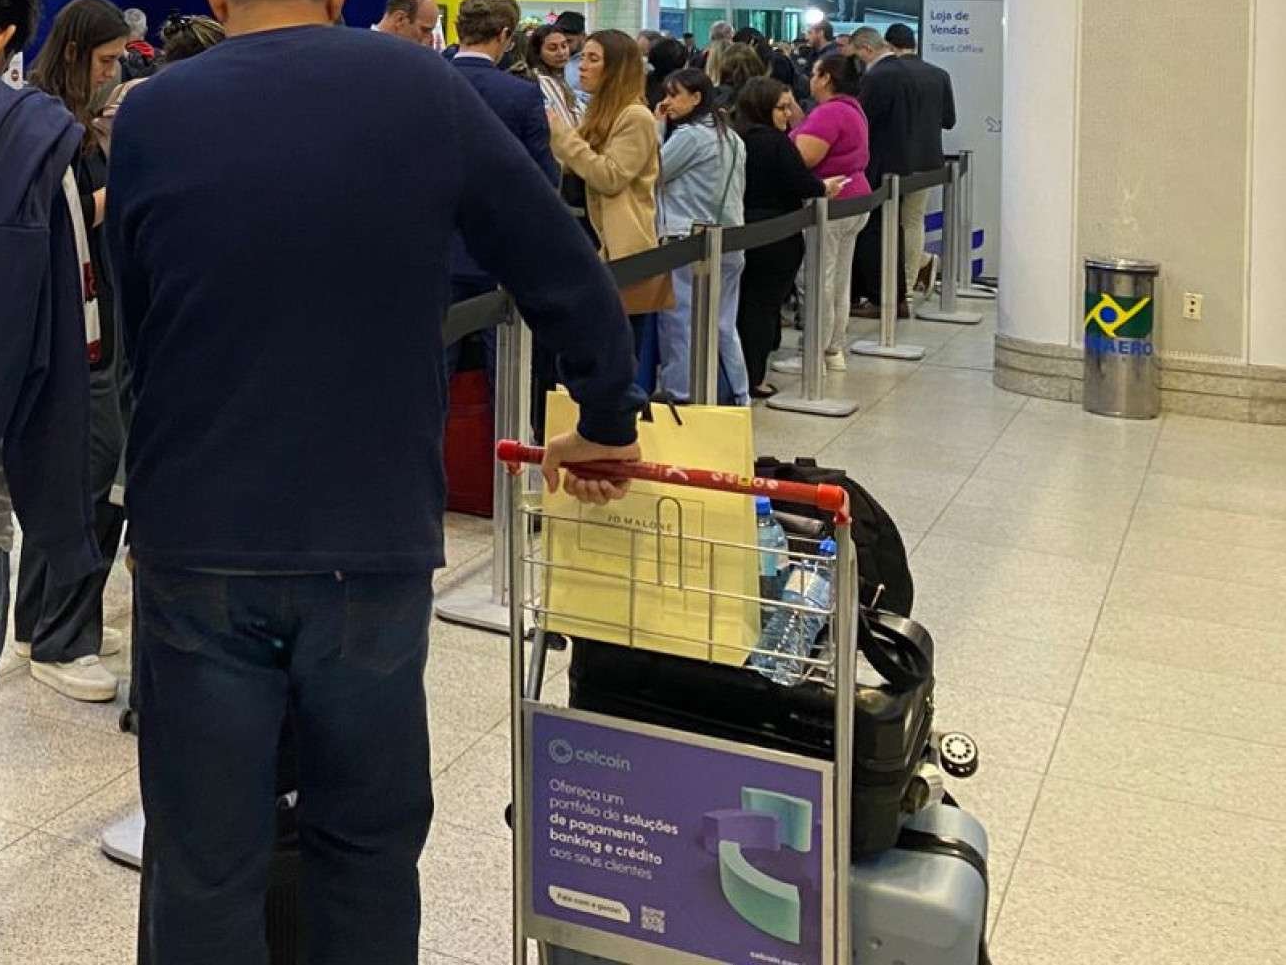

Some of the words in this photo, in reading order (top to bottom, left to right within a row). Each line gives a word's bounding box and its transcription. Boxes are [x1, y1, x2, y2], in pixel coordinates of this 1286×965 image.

[930, 10, 952, 23] Loja
[954, 9, 970, 21] de
[930, 23, 970, 35] Vendas
[575, 748, 632, 772] celcoin
[549, 778, 601, 801] Ofereça
[602, 794, 625, 806] um
[549, 812, 567, 826] de
[602, 808, 620, 821] de
[622, 813, 679, 835] soluções
[549, 827, 602, 854] banking
[604, 843, 613, 854] e
[615, 846, 663, 865] crédito
[549, 846, 572, 861] aos
[573, 852, 603, 868] seus
[604, 858, 653, 880] clientes
